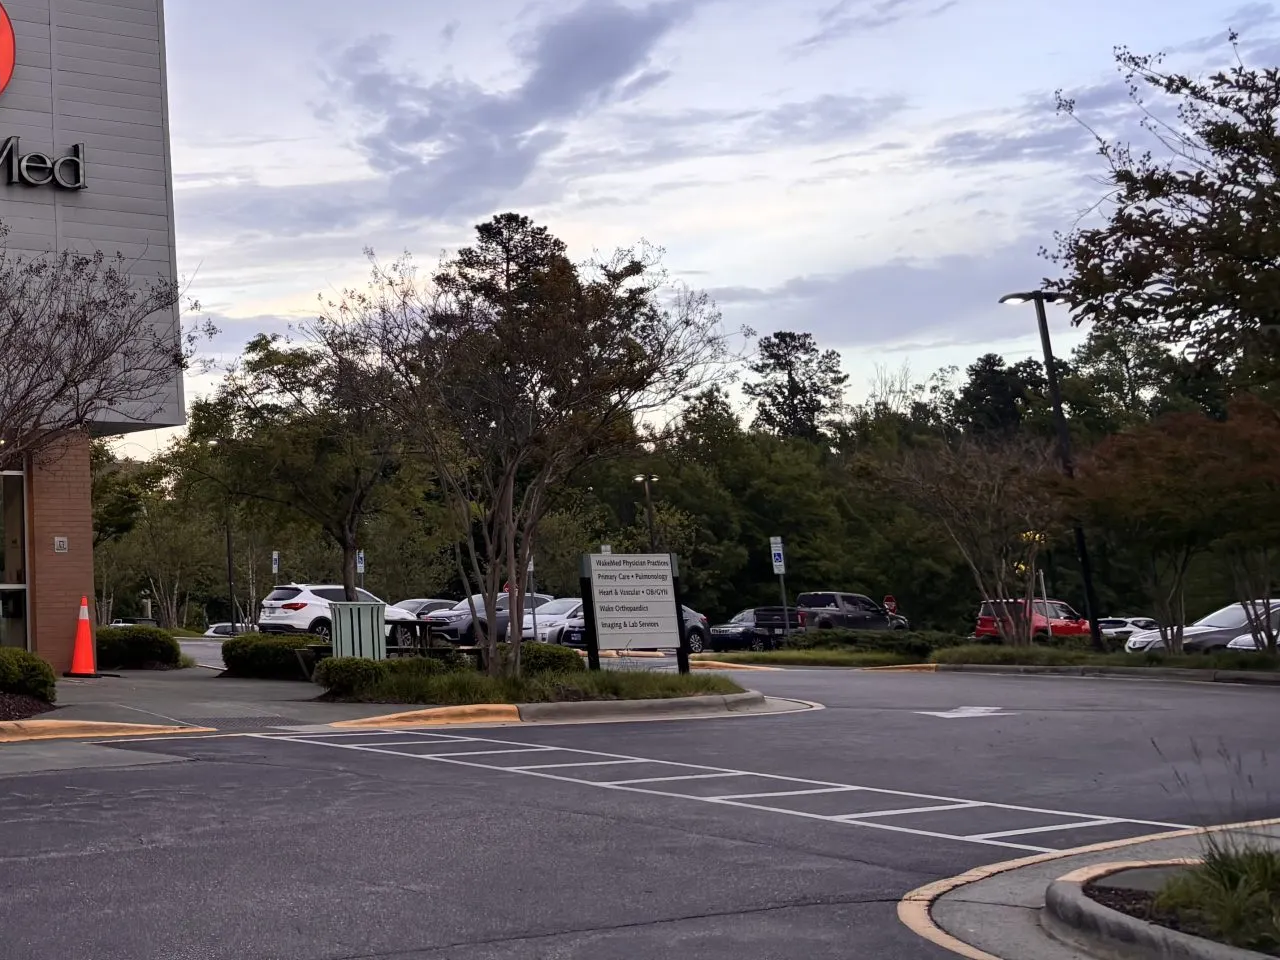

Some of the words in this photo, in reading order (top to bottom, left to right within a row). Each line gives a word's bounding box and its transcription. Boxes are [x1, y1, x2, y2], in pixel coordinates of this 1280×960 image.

[598, 573, 617, 581] Primary
[635, 573, 668, 581] Pulmonology
[602, 621, 622, 629] Imaging
